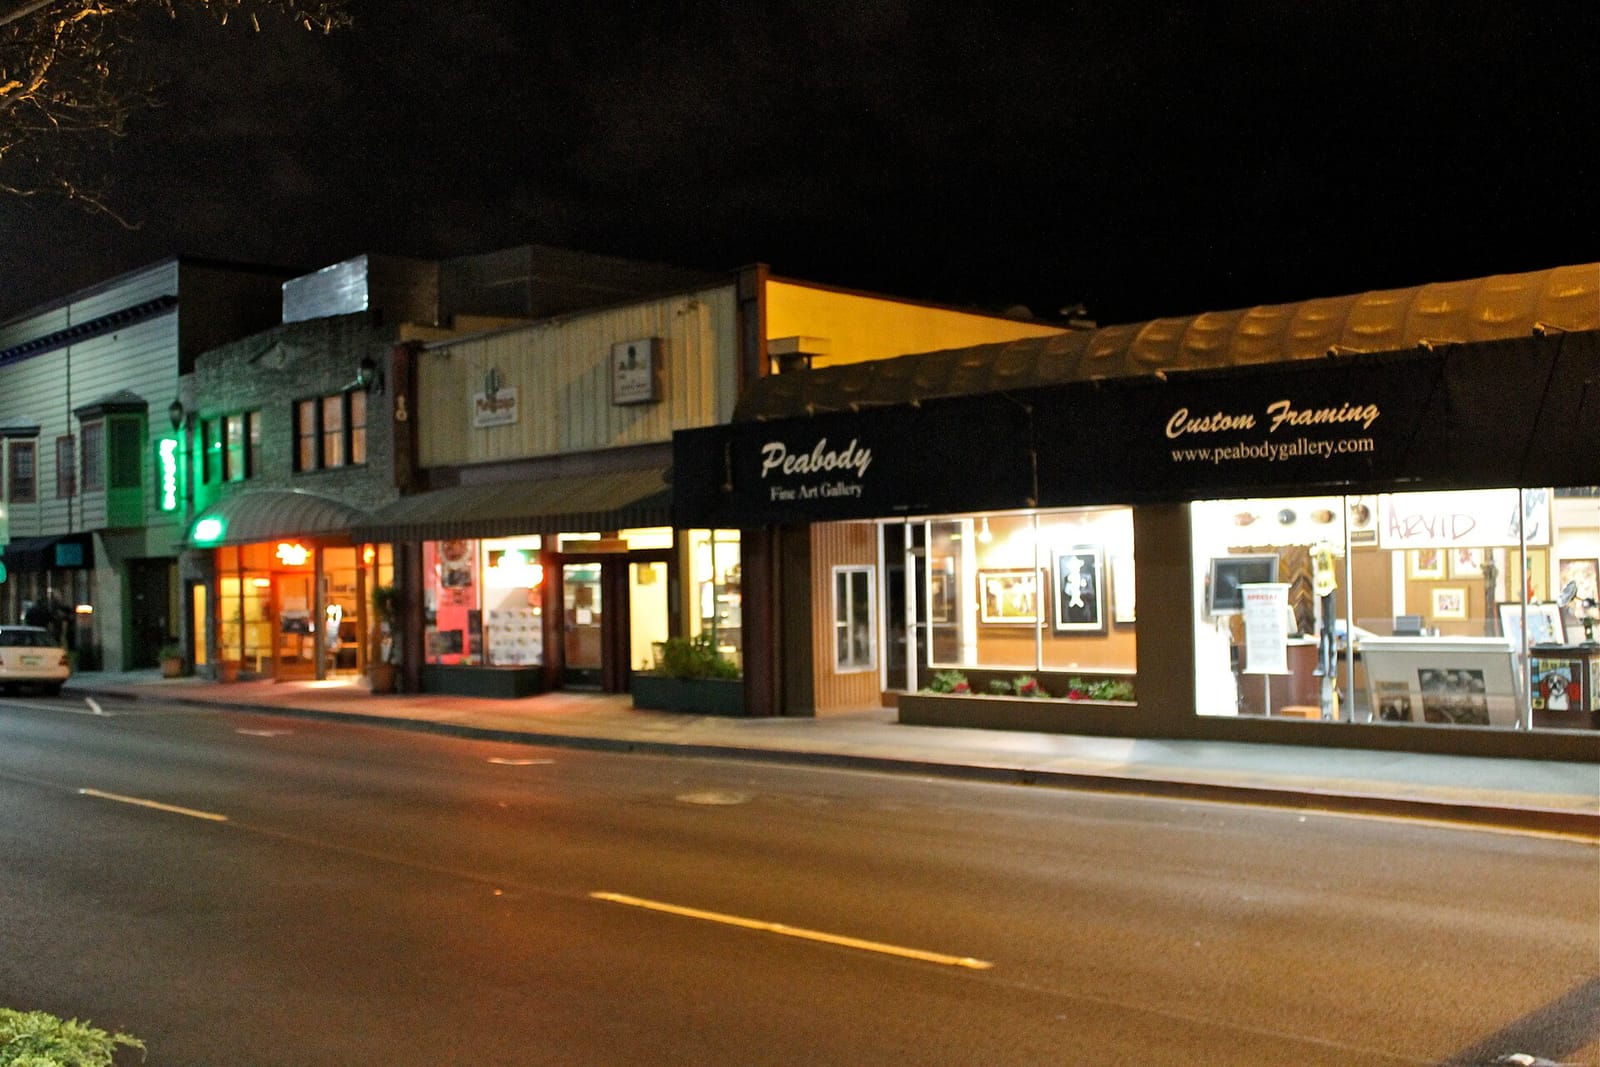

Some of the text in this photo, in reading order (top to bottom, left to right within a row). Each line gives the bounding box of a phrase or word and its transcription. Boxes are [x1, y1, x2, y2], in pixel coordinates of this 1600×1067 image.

[1166, 400, 1380, 438] Custom Framing
[761, 438, 872, 478] Peabody
[1172, 438, 1375, 464] www.peabodygallery.com
[770, 481, 863, 501] Fine Art Gallery
[1388, 502, 1476, 540] ARVID
